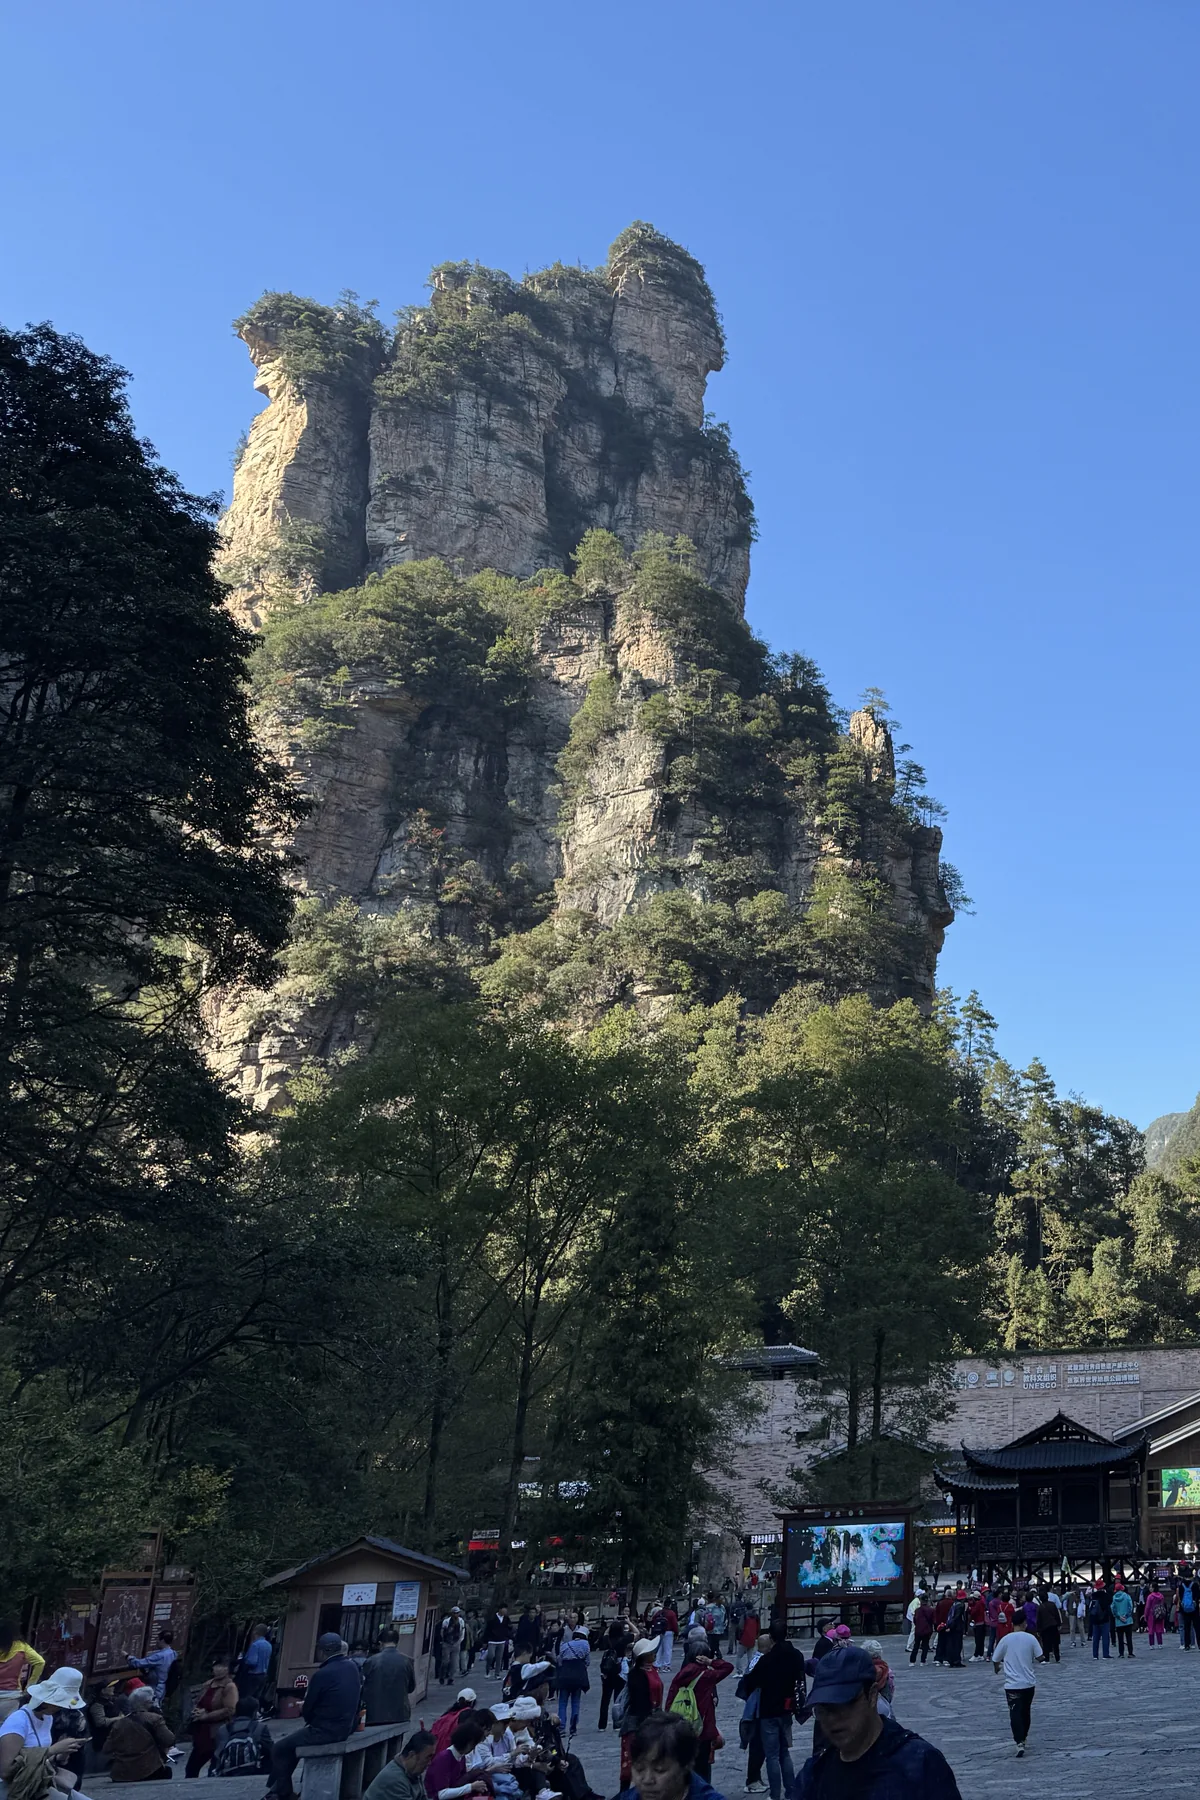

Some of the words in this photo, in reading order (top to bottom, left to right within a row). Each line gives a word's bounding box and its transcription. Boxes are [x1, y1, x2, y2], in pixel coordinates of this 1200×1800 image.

[1023, 1365, 1056, 1374] 联合国
[1023, 1374, 1057, 1383] 教科文组织
[1023, 1382, 1056, 1390] UNESCO
